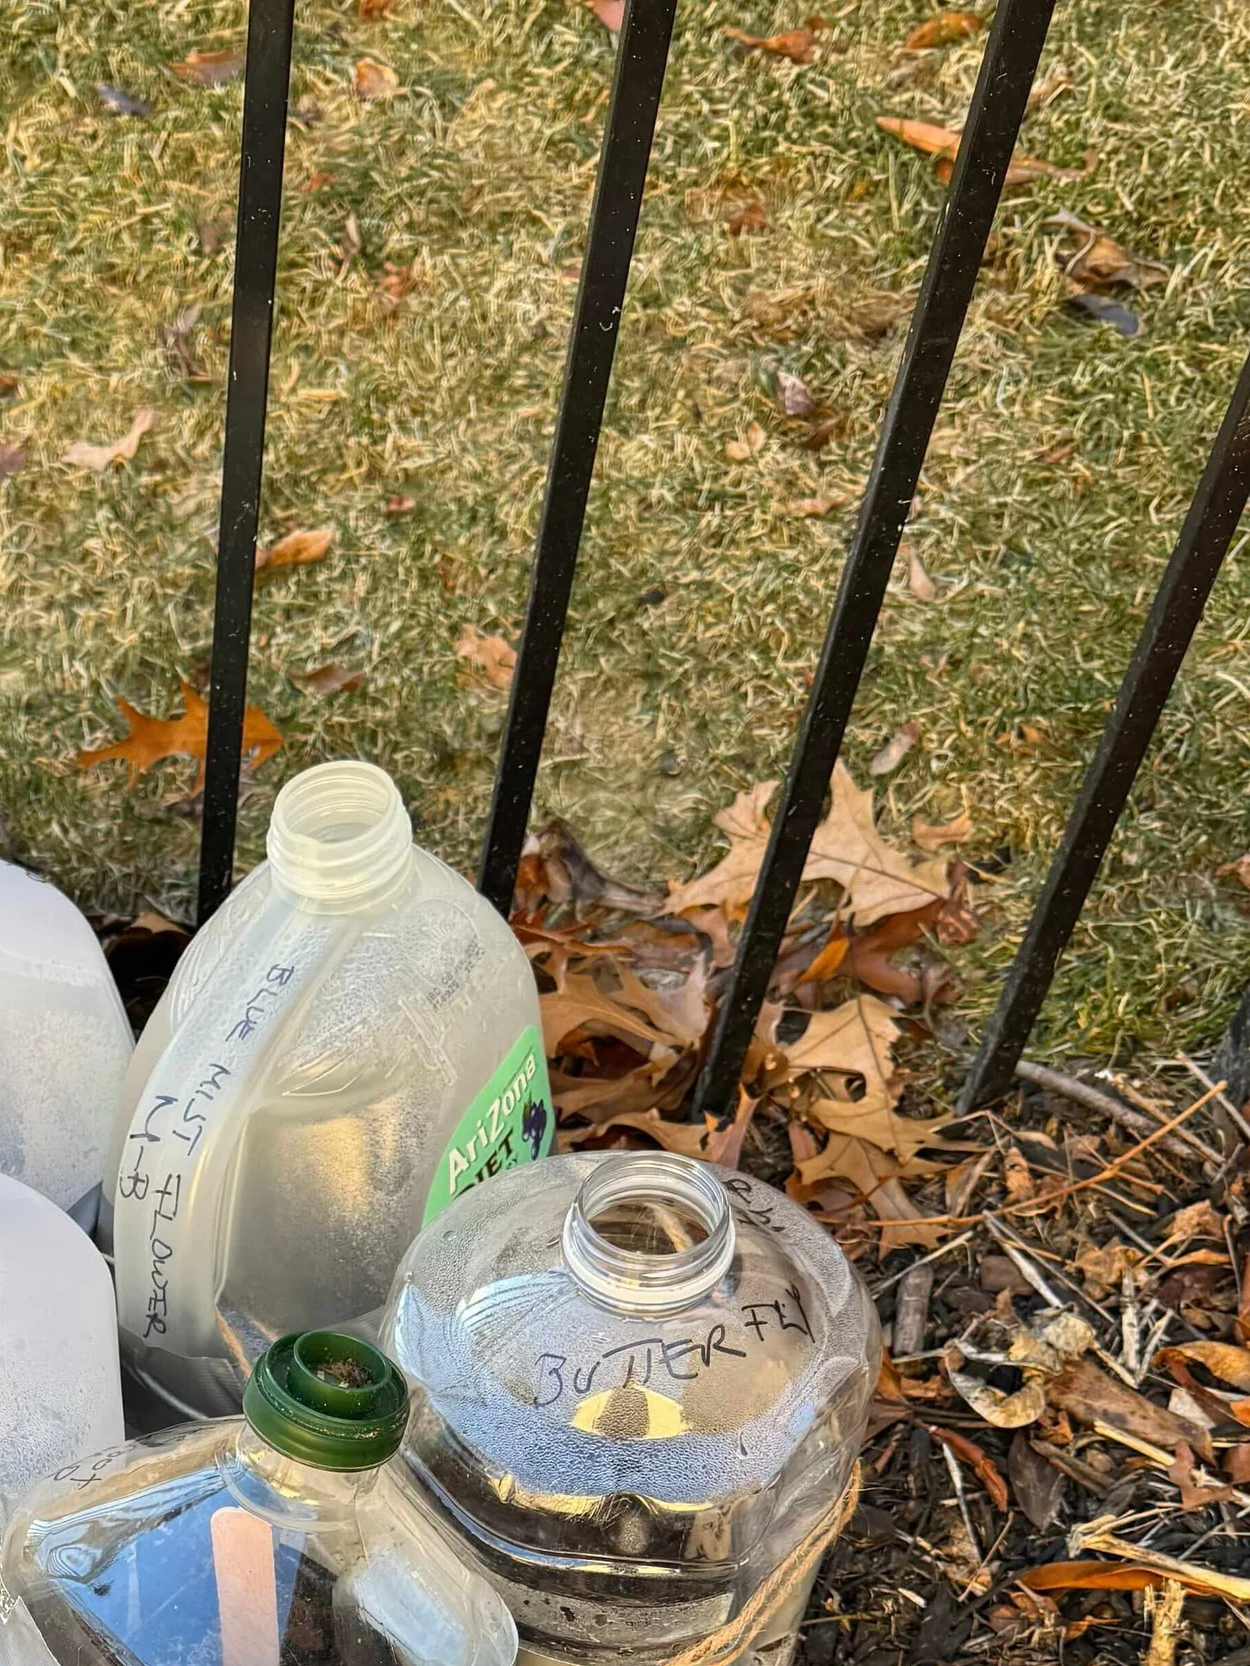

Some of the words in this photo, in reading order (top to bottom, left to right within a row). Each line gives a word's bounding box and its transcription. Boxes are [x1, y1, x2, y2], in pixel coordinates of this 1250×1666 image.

[226, 963, 294, 1041] BLUE
[172, 1063, 232, 1156] MIST
[449, 1053, 537, 1195] AriZona
[453, 1126, 515, 1199] IET
[142, 1172, 181, 1338] FLOWER
